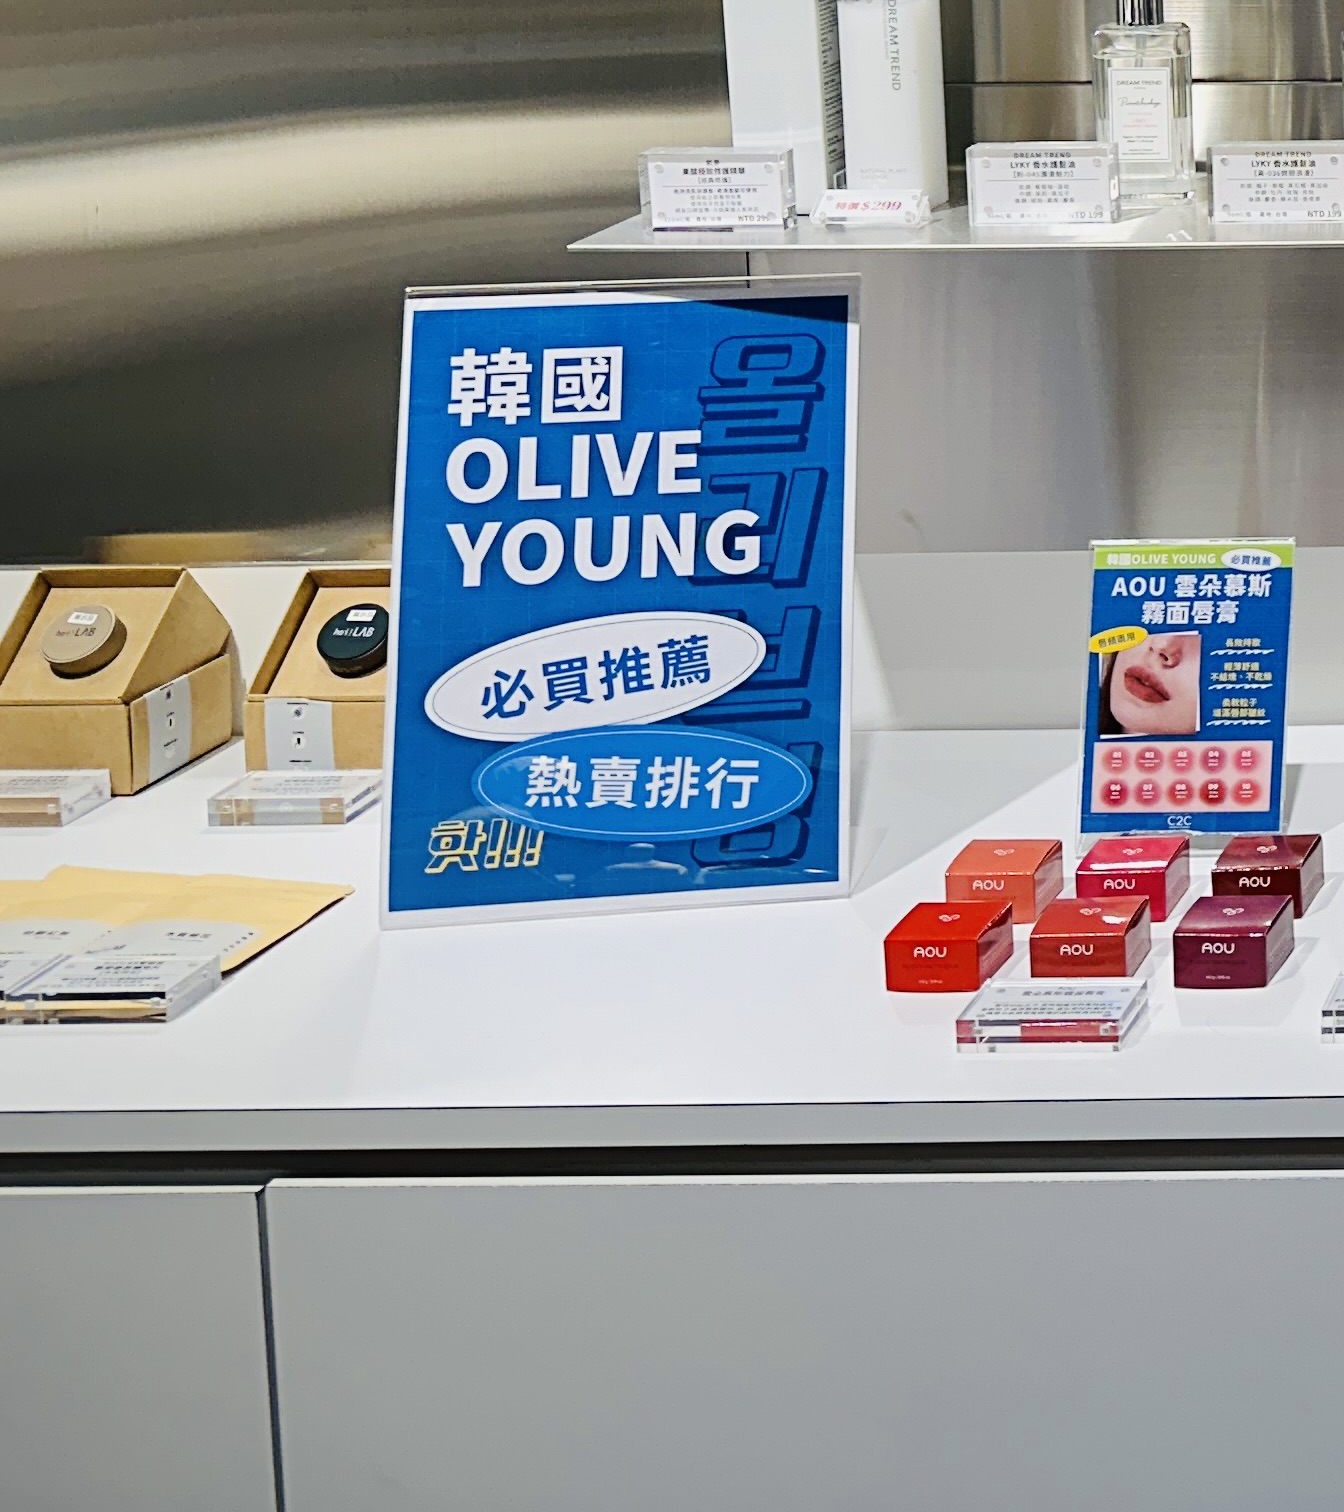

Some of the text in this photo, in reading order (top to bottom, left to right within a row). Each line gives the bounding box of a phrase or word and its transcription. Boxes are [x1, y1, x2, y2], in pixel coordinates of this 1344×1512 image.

[890, 48, 902, 91] TREND
[446, 345, 624, 427] 韓國
[445, 429, 702, 504] OLIVE
[445, 508, 761, 588] YOUNG
[1172, 553, 1216, 565] YOUNG
[1111, 573, 1272, 598] AOU 雲朵慕斯
[1141, 600, 1240, 625] 霧面唇膏
[480, 634, 711, 720] 必買推薦
[524, 754, 760, 810] 熱賣排行
[1167, 816, 1192, 826] C2C
[972, 879, 1005, 891] AOU
[1103, 878, 1136, 890] AOU
[1238, 876, 1271, 888] AOU
[913, 946, 947, 958] AOU
[1059, 943, 1094, 956] AOU
[1201, 942, 1235, 954] AOU
